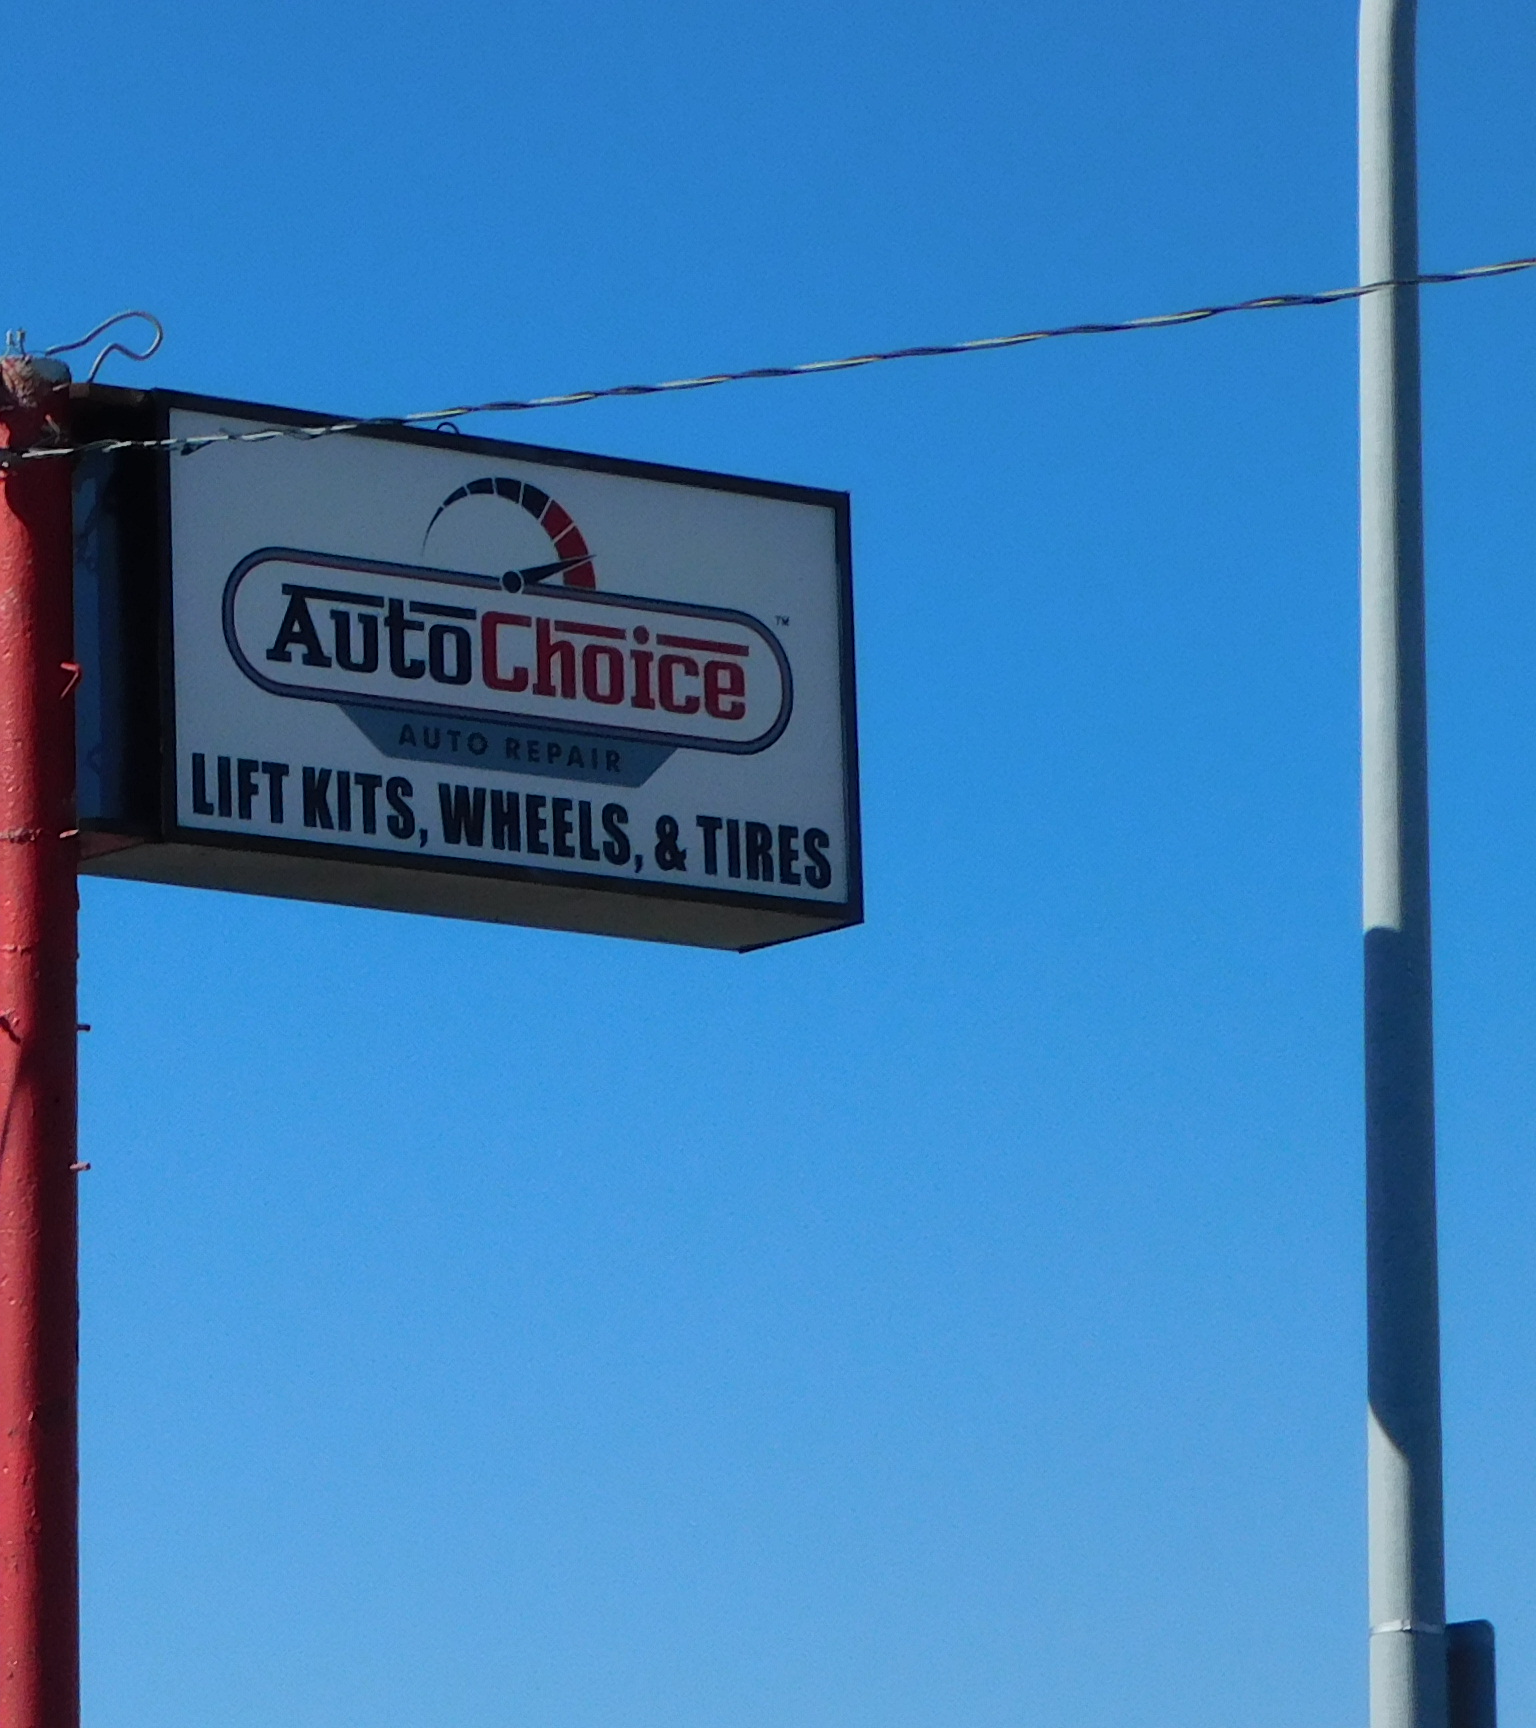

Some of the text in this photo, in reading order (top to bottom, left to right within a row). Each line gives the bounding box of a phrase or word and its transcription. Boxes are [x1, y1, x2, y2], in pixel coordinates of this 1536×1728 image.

[398, 723, 622, 774] AUTO REPAIR
[191, 752, 832, 890] LIFT KITS, WHEELS, & TIRES
